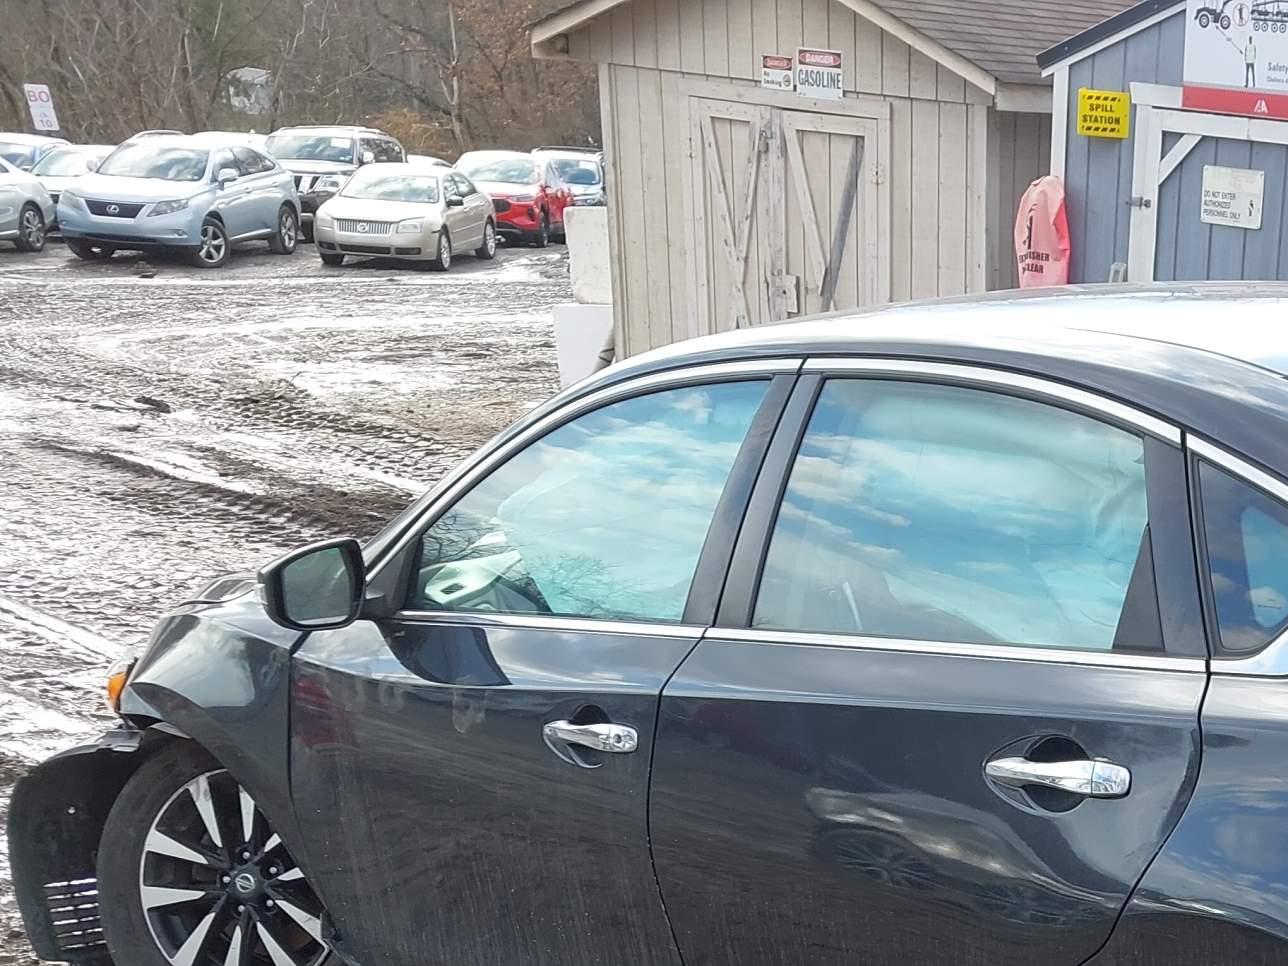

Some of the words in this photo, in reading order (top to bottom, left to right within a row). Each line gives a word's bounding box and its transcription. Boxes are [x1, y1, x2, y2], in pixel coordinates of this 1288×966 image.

[1267, 62, 1288, 74] Safety
[798, 69, 841, 89] GASOLINE
[1089, 103, 1114, 112] SPILL
[1082, 114, 1120, 125] STATION
[1204, 190, 1211, 198] DO
[1212, 191, 1221, 199] NOT
[1222, 192, 1236, 200] ENTER
[1204, 200, 1231, 209] AUTHORIZED
[1203, 209, 1228, 218] PERSONNEL
[1229, 211, 1241, 220] ONLY
